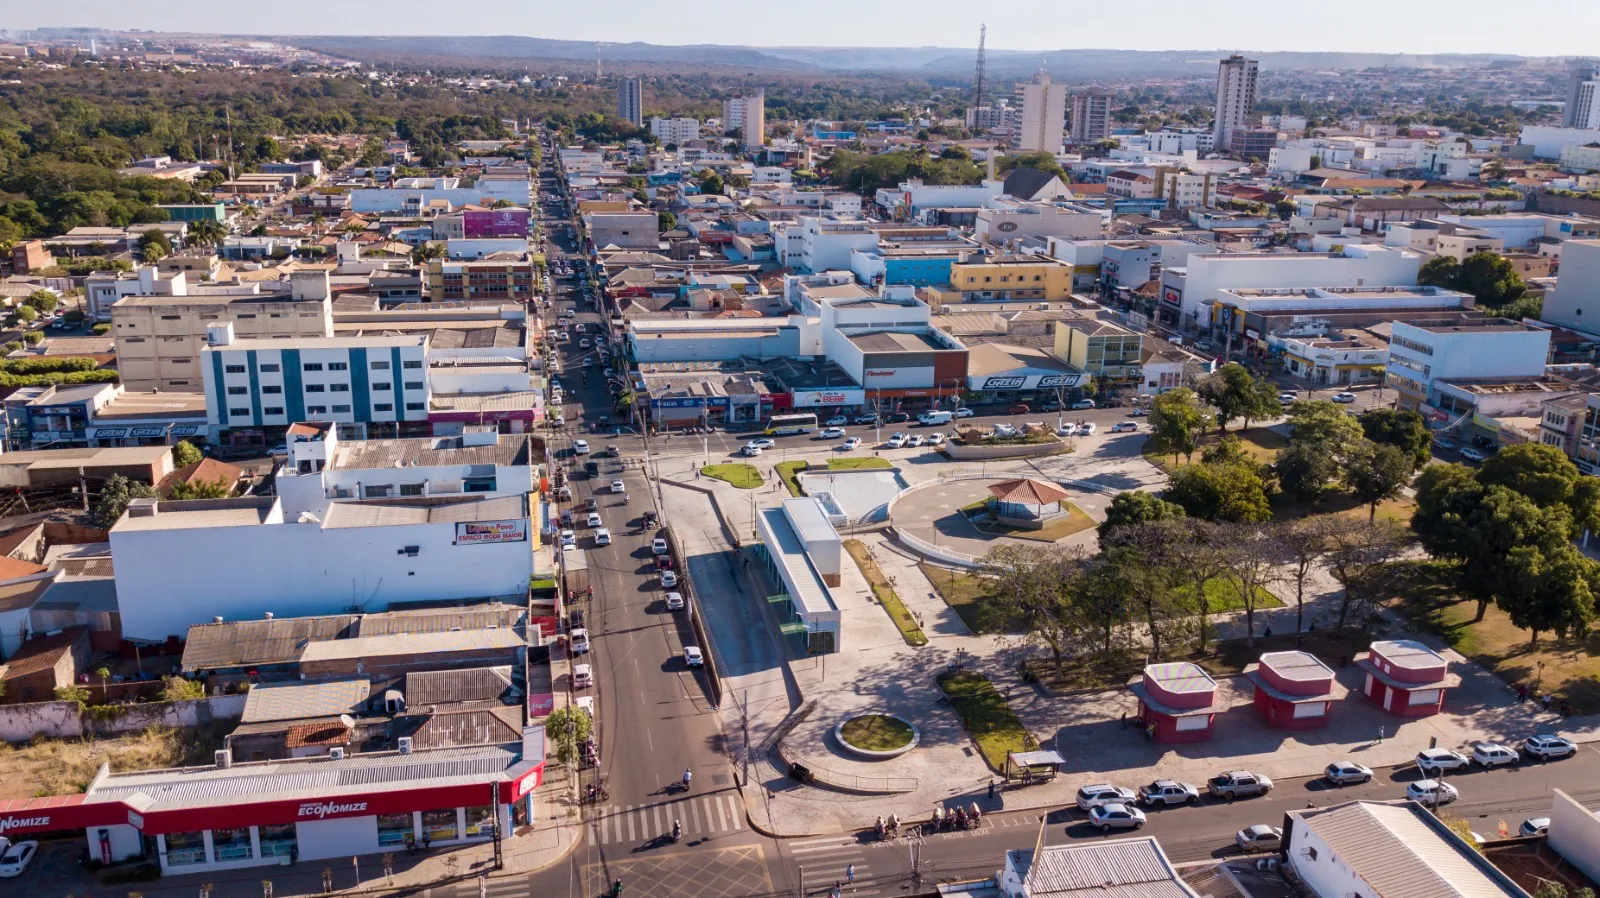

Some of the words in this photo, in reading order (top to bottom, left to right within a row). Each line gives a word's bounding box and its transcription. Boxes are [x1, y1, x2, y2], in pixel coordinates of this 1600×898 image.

[986, 377, 1025, 388] GAZIN
[1039, 375, 1080, 387] GAZIN
[823, 394, 846, 403] BEBÊ
[95, 429, 126, 437] GAZIN
[131, 428, 161, 437] GAZIN
[298, 801, 368, 818] ECONOMIZE
